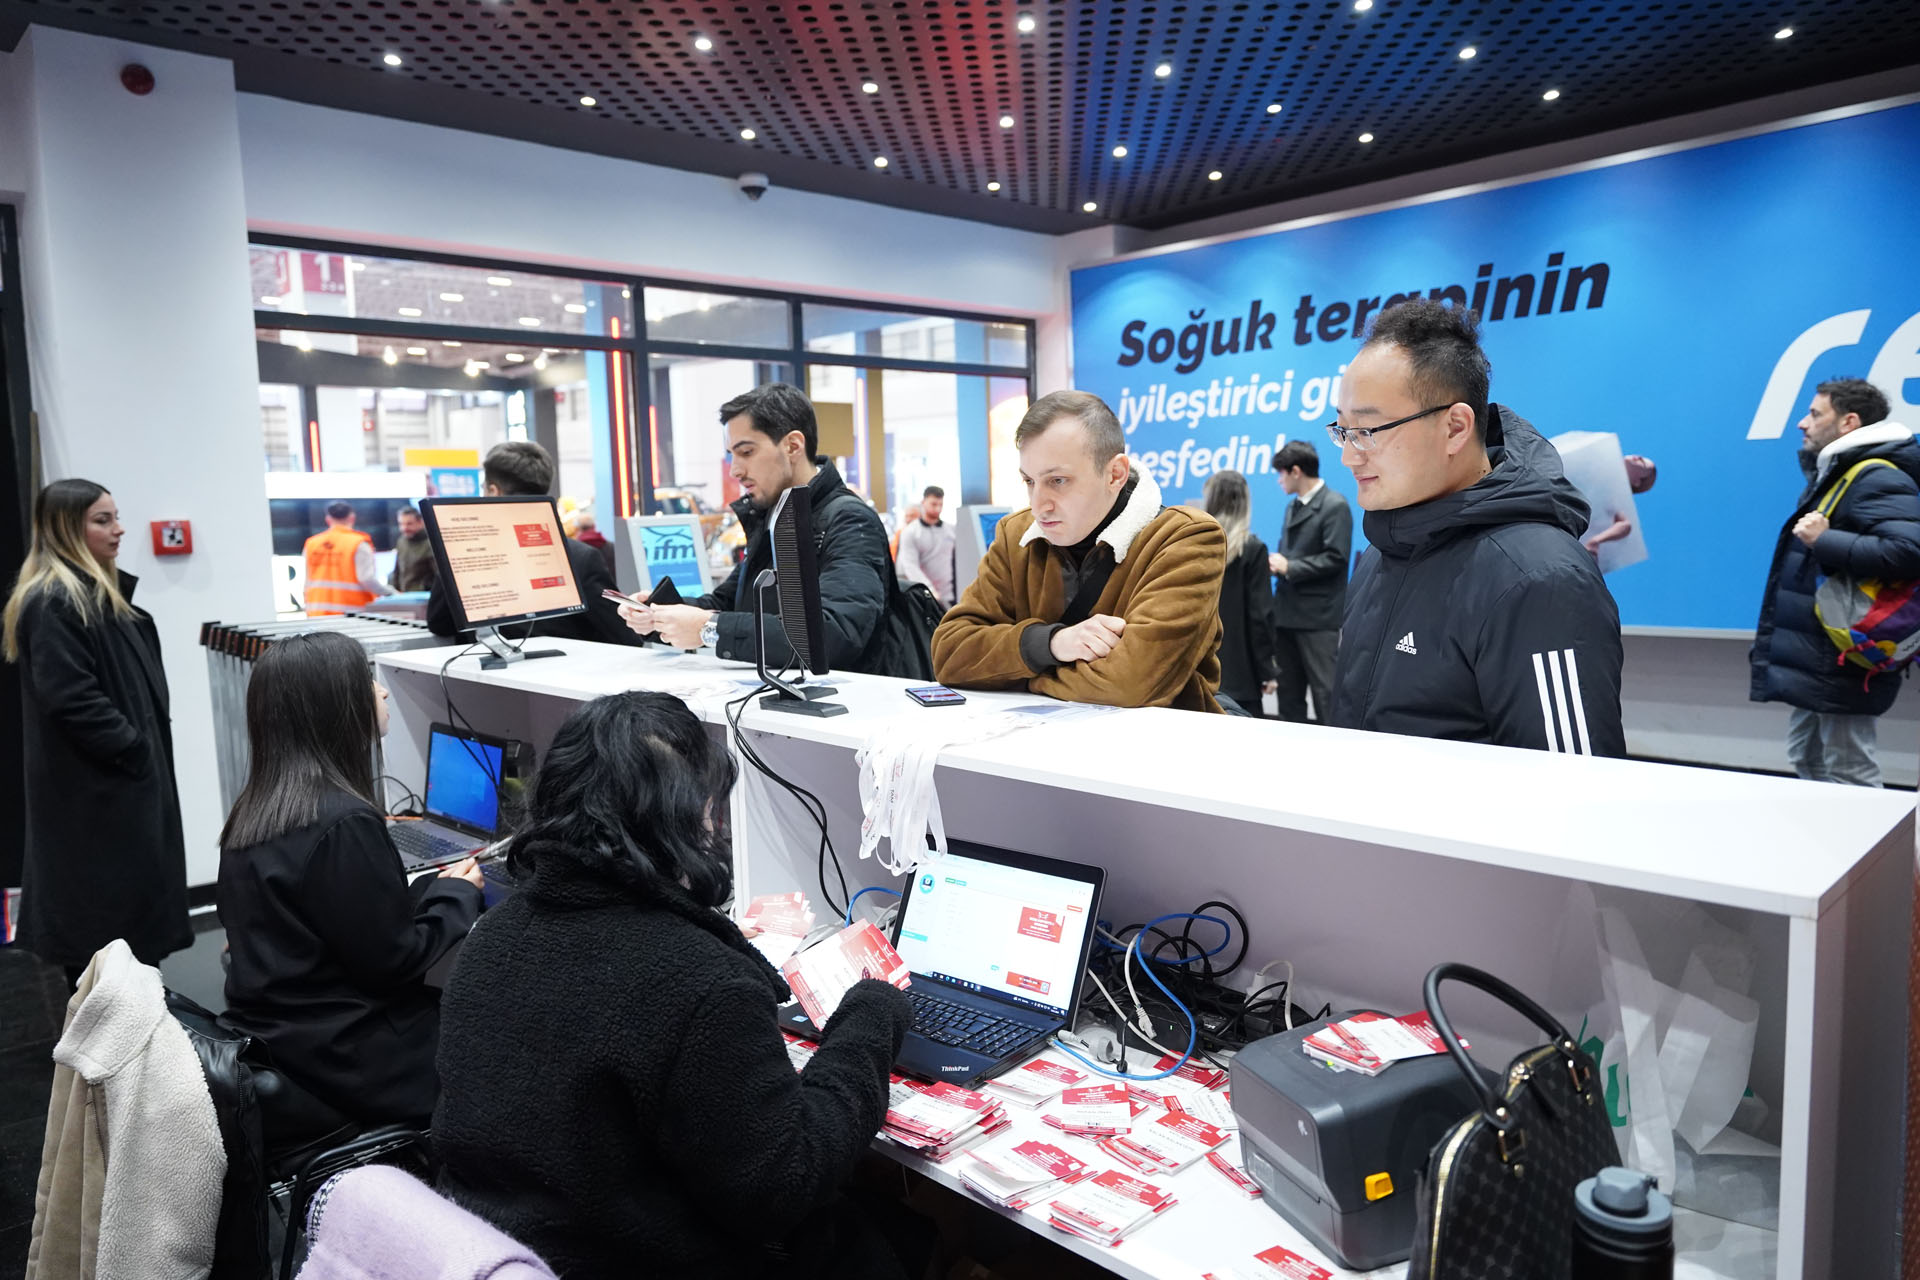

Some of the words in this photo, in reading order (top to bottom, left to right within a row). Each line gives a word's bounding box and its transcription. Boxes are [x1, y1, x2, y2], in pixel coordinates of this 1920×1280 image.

[1117, 299, 1277, 375] Soğuk
[1118, 369, 1295, 435] iyileştirici
[1124, 433, 1287, 488] eşfedin!
[1395, 643, 1418, 655] adidas
